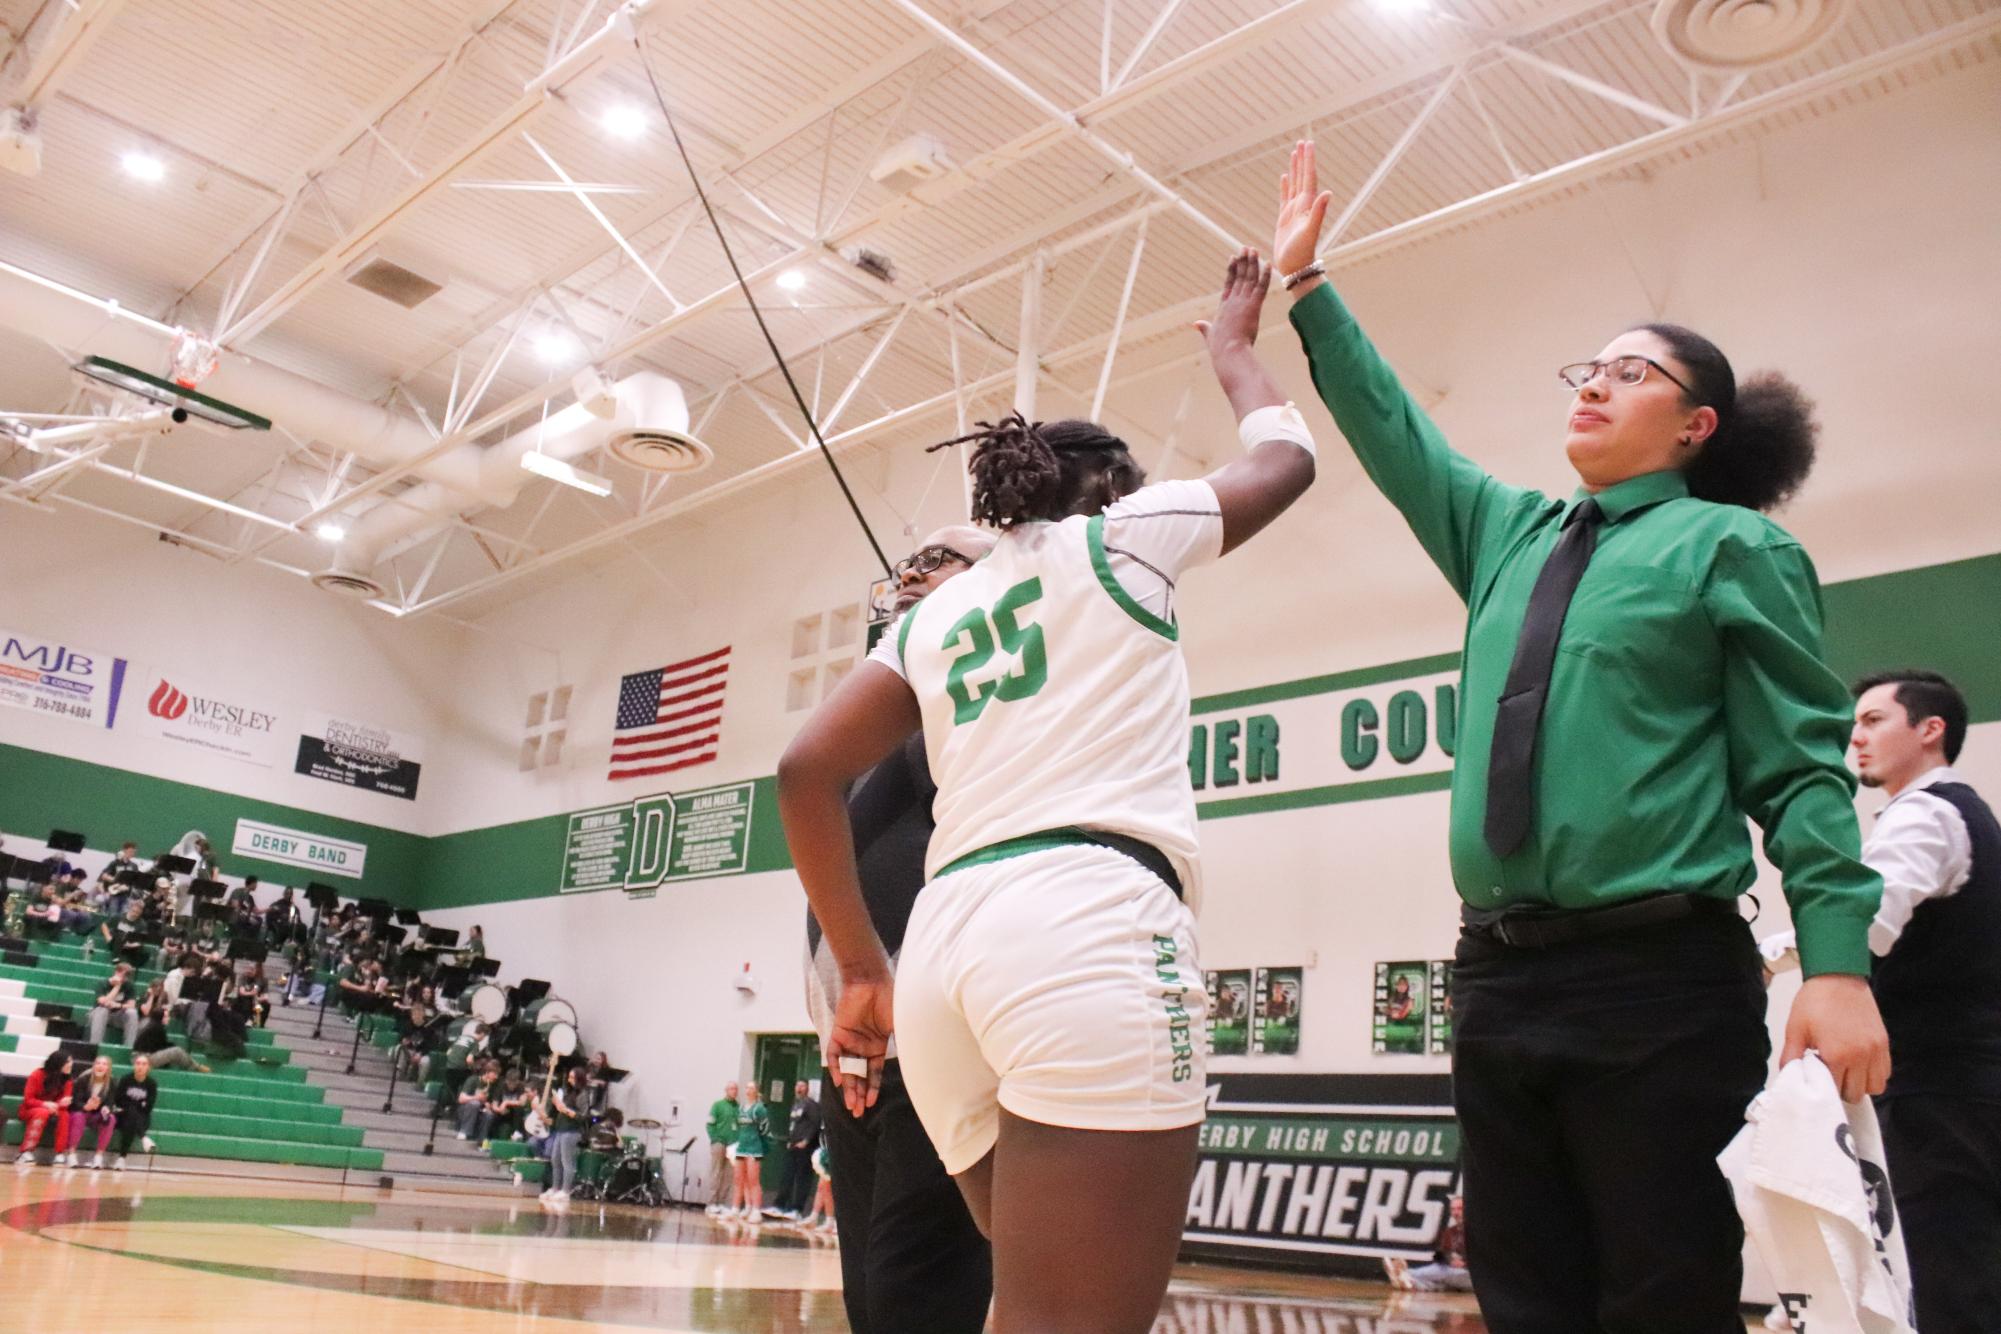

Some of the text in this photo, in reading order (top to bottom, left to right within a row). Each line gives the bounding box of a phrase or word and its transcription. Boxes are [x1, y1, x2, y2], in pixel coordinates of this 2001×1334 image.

[3, 638, 93, 676] MJB
[941, 575, 1048, 727] 25
[188, 713, 243, 737] Derby ER
[192, 696, 277, 732] WESLEY
[326, 728, 389, 750] DENTISTRY
[331, 745, 400, 769] ORTHODONTICS
[251, 833, 347, 864] DERBY BAND
[1266, 1127, 1329, 1152] HIGH
[1340, 1128, 1444, 1156] SCHOOL
